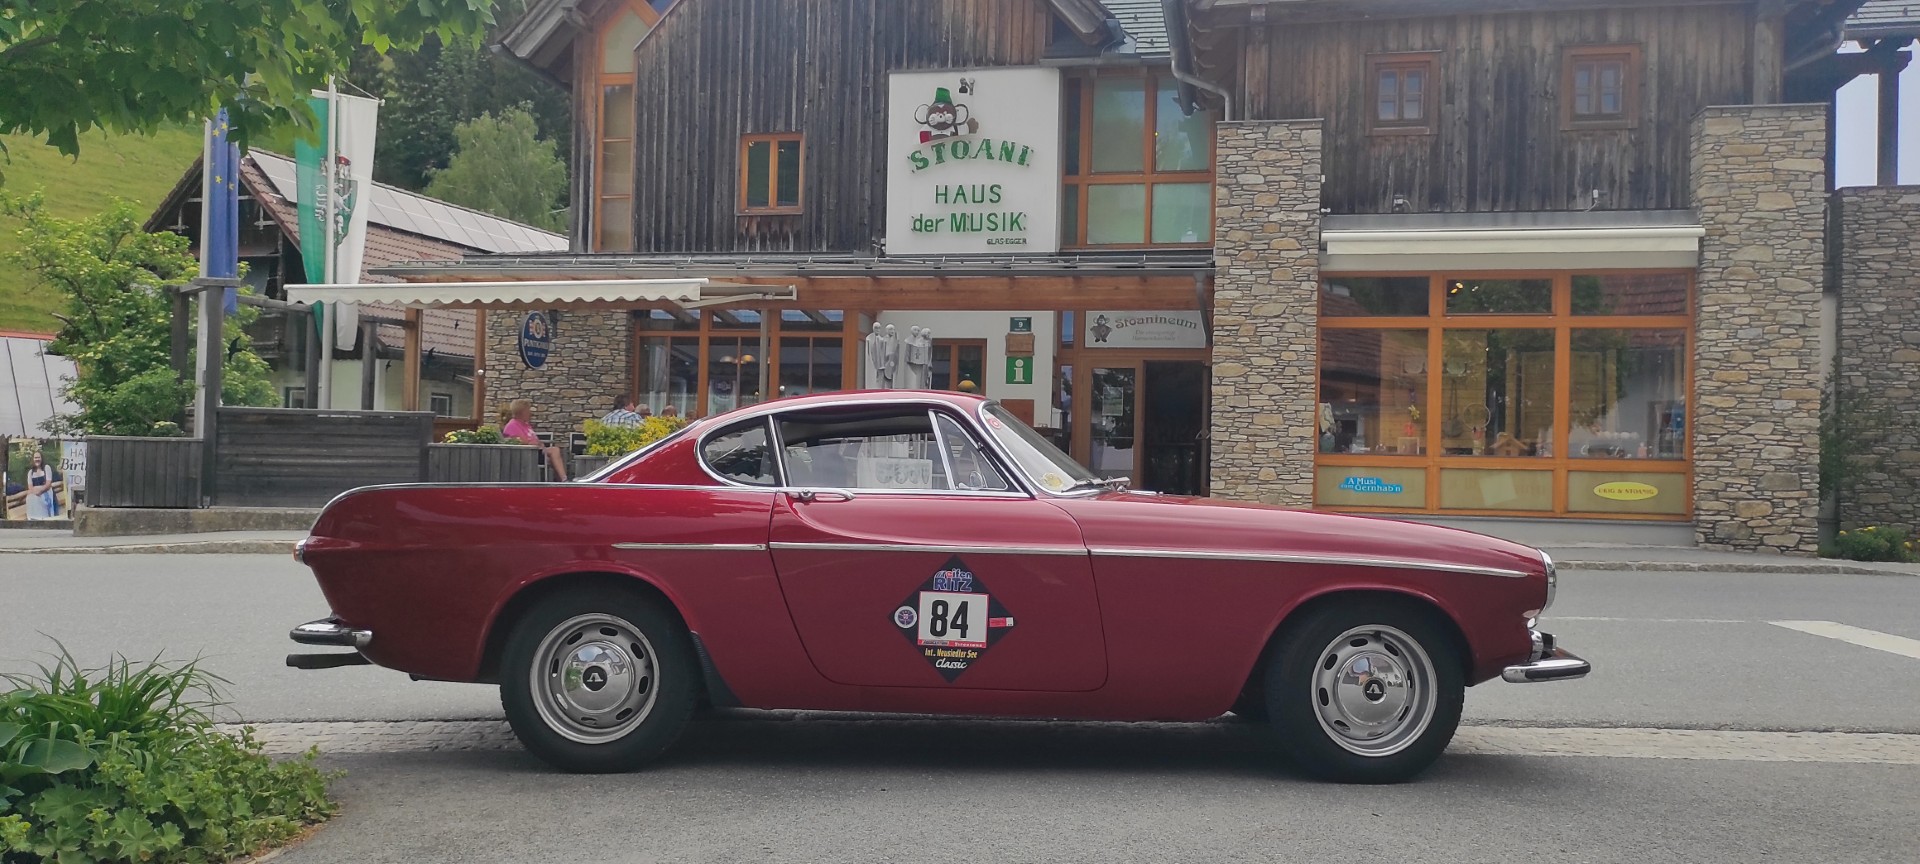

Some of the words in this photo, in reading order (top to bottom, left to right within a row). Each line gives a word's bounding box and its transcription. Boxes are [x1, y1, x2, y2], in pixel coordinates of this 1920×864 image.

[910, 138, 1031, 170] STOANI
[935, 184, 1002, 204] HAUS
[912, 213, 945, 233] der
[950, 212, 1024, 233] MUSIK
[1115, 314, 1198, 329] Stoanineum
[71, 448, 86, 458] HA
[59, 458, 86, 471] Birt
[68, 474, 82, 485] TO
[1347, 477, 1355, 485] A
[1356, 477, 1377, 485] Musi
[933, 577, 973, 592] RITZ
[930, 600, 969, 639] 84
[925, 648, 936, 657] Int.
[936, 648, 967, 658] Neusiedler
[967, 650, 978, 659] See
[935, 658, 968, 669] Classic
